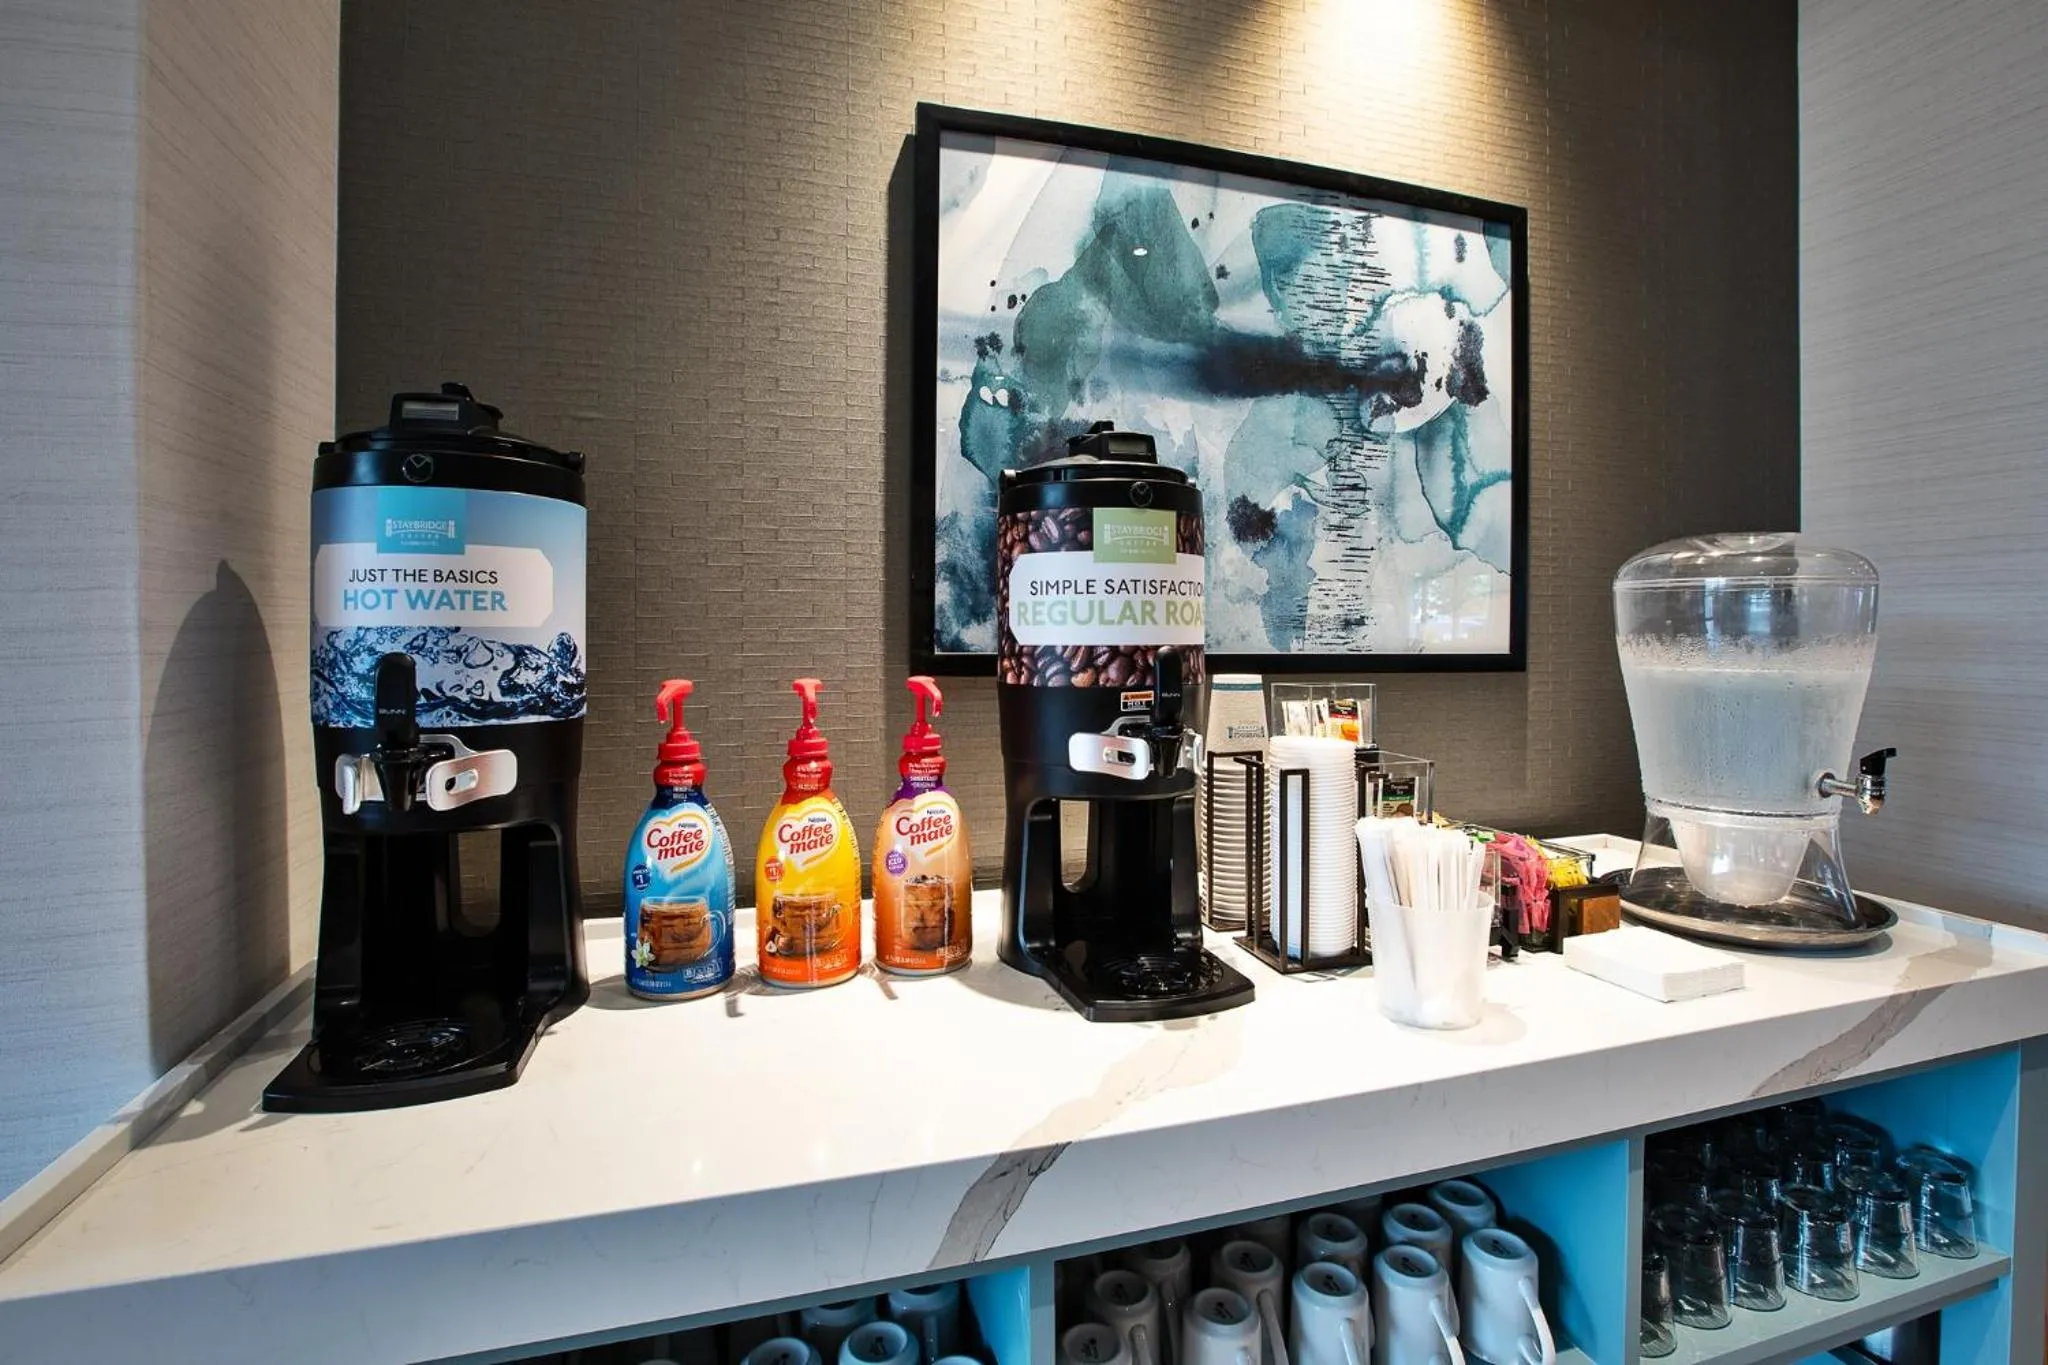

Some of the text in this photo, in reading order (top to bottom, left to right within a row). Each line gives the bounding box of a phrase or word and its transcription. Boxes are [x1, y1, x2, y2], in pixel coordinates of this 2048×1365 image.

[349, 568, 498, 584] JUST THE BASICS
[1030, 578, 1097, 596] SIMPLE
[343, 588, 508, 612] HOT WATER
[1017, 599, 1159, 626] REGULAR
[778, 823, 832, 843] Coffee
[895, 815, 952, 836] Coffee
[910, 824, 953, 846] mate
[646, 828, 703, 848] Coffee
[789, 833, 834, 855] mate
[657, 840, 704, 860] mate
